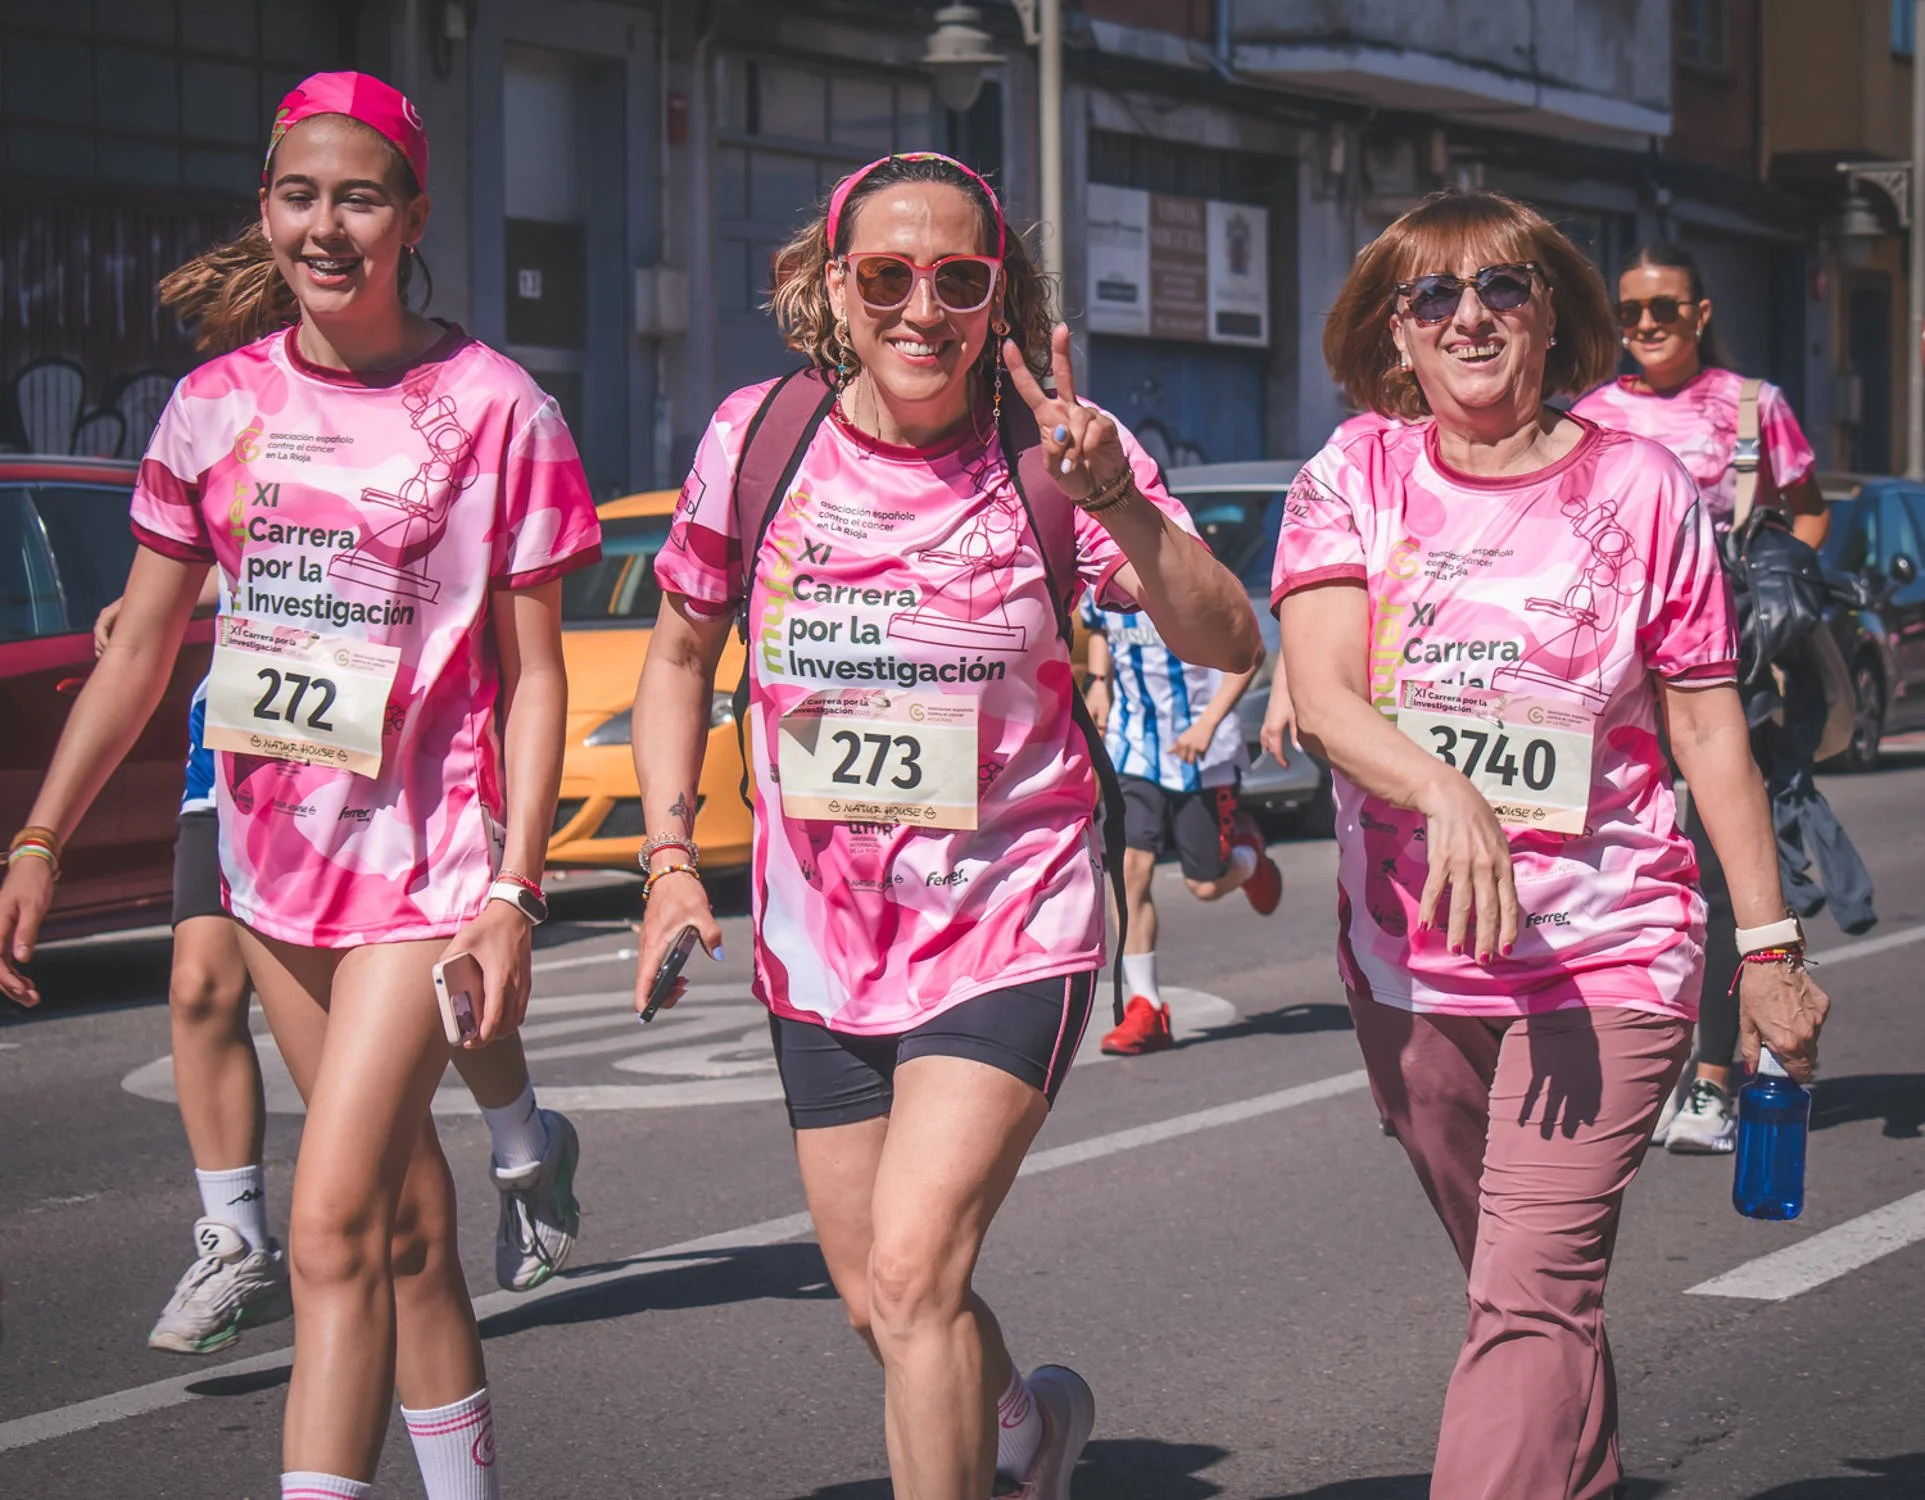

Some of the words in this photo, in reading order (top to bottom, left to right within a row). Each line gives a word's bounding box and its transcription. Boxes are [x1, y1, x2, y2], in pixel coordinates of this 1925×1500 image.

[268, 442, 295, 451] contra
[296, 443, 304, 451] el
[277, 452, 288, 460] La
[290, 453, 311, 463] Rioja
[251, 482, 280, 507] XI
[819, 511, 849, 525] contra
[851, 517, 860, 526] el
[820, 500, 871, 517] asociación
[872, 510, 915, 521] española
[249, 517, 355, 550] Carrera
[830, 524, 842, 532] La
[843, 527, 868, 539] Rioja
[797, 537, 832, 565] XI
[248, 557, 293, 583] por
[299, 555, 322, 583] la
[792, 574, 917, 608] Carrera
[248, 586, 415, 628] Investigación
[1408, 602, 1436, 627] XI
[243, 630, 273, 642] Carrera
[788, 617, 843, 646] por
[850, 615, 881, 645] la
[1403, 637, 1519, 664] Carrera
[789, 650, 1006, 688] Investigación
[253, 667, 337, 732] 272
[843, 699, 858, 707] por
[1414, 688, 1426, 698] XI
[1428, 691, 1461, 702] Carrera
[1462, 697, 1477, 705] por
[1479, 698, 1488, 707] la
[831, 730, 922, 790] 273
[1429, 725, 1556, 791] 3740
[1525, 911, 1569, 929] Ferrer
